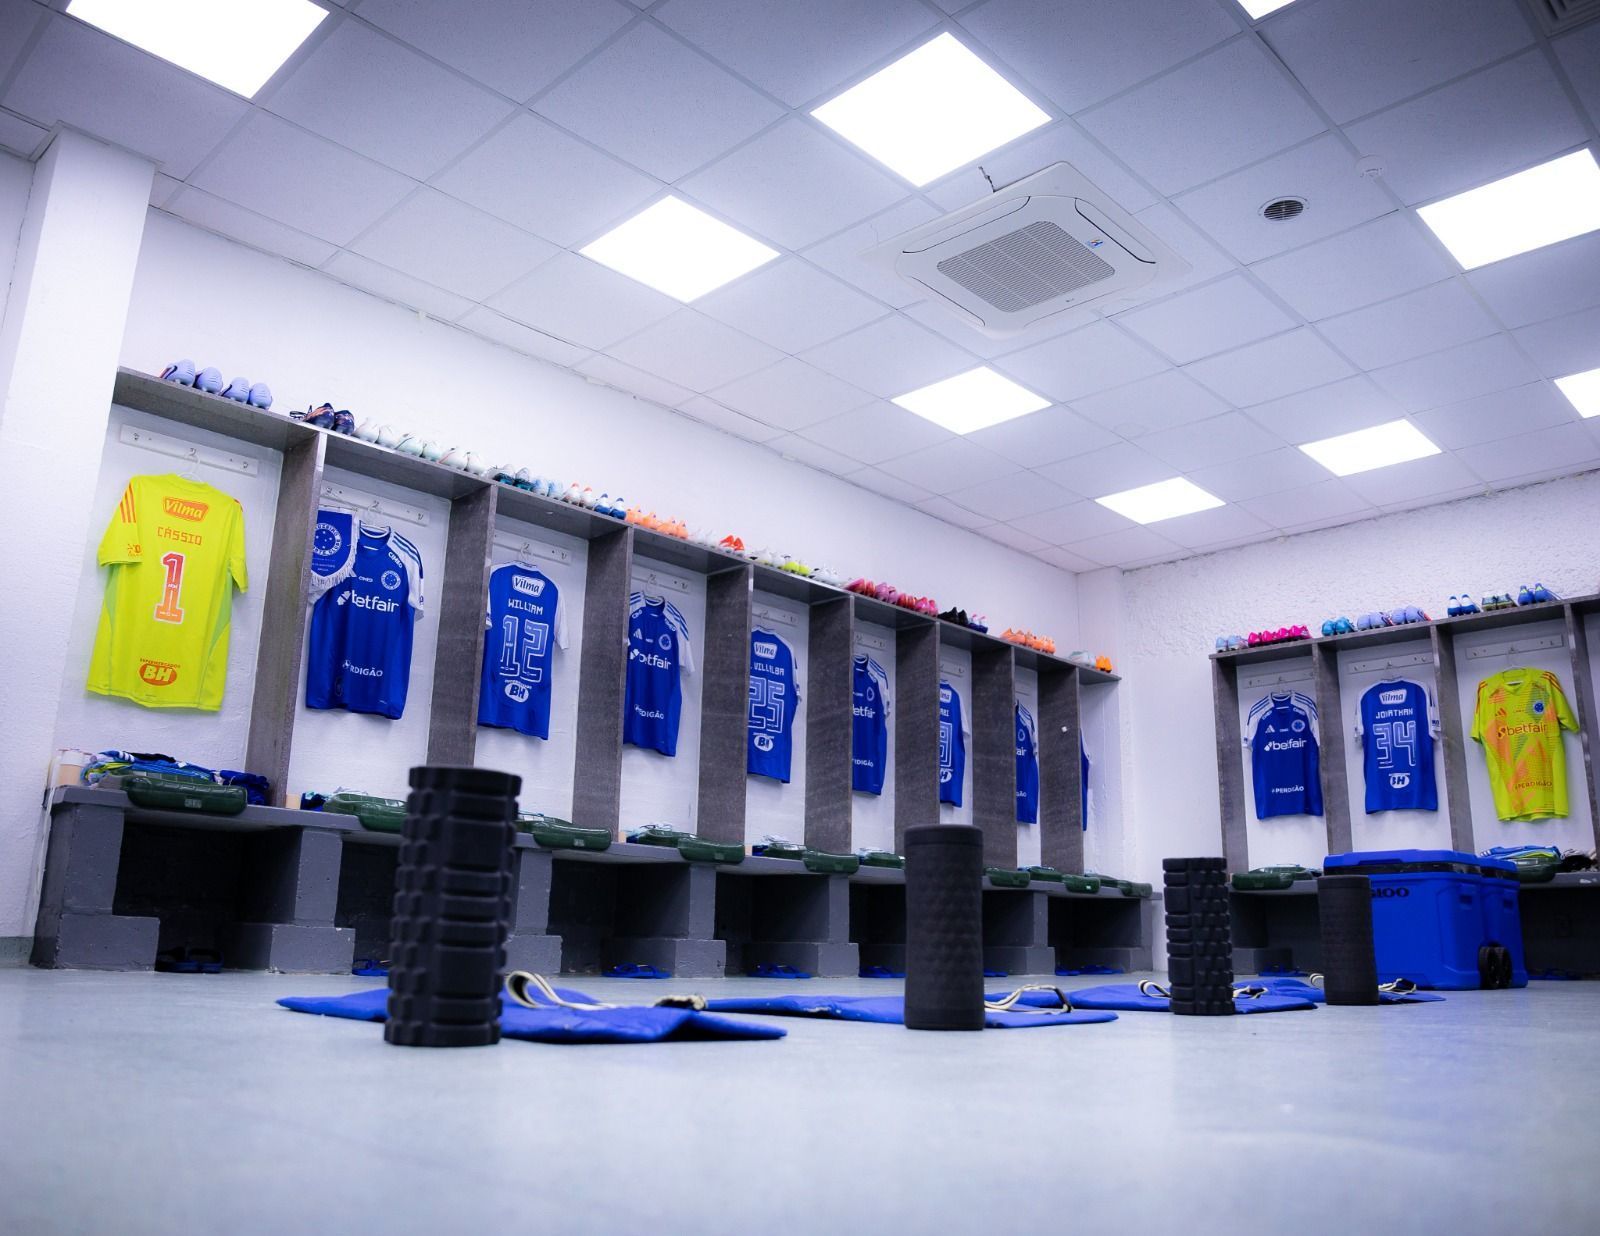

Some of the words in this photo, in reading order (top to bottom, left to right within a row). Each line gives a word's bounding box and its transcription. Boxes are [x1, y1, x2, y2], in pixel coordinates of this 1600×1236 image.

[164, 499, 204, 519] Vilma
[157, 526, 203, 546] CÁSSIO
[153, 552, 185, 624] 1
[514, 577, 541, 594] Vilma
[508, 598, 544, 615] WILLIAM
[499, 615, 549, 682] 12
[143, 664, 173, 682] BH
[350, 664, 384, 677] RDIGÃO
[509, 684, 526, 699] BH
[748, 675, 785, 733] 25
[639, 708, 665, 720] DIGÃO
[1507, 722, 1548, 736] betfair
[1372, 720, 1417, 769] 34
[853, 759, 874, 768] DIGÃO
[1369, 887, 1409, 898] LOO
